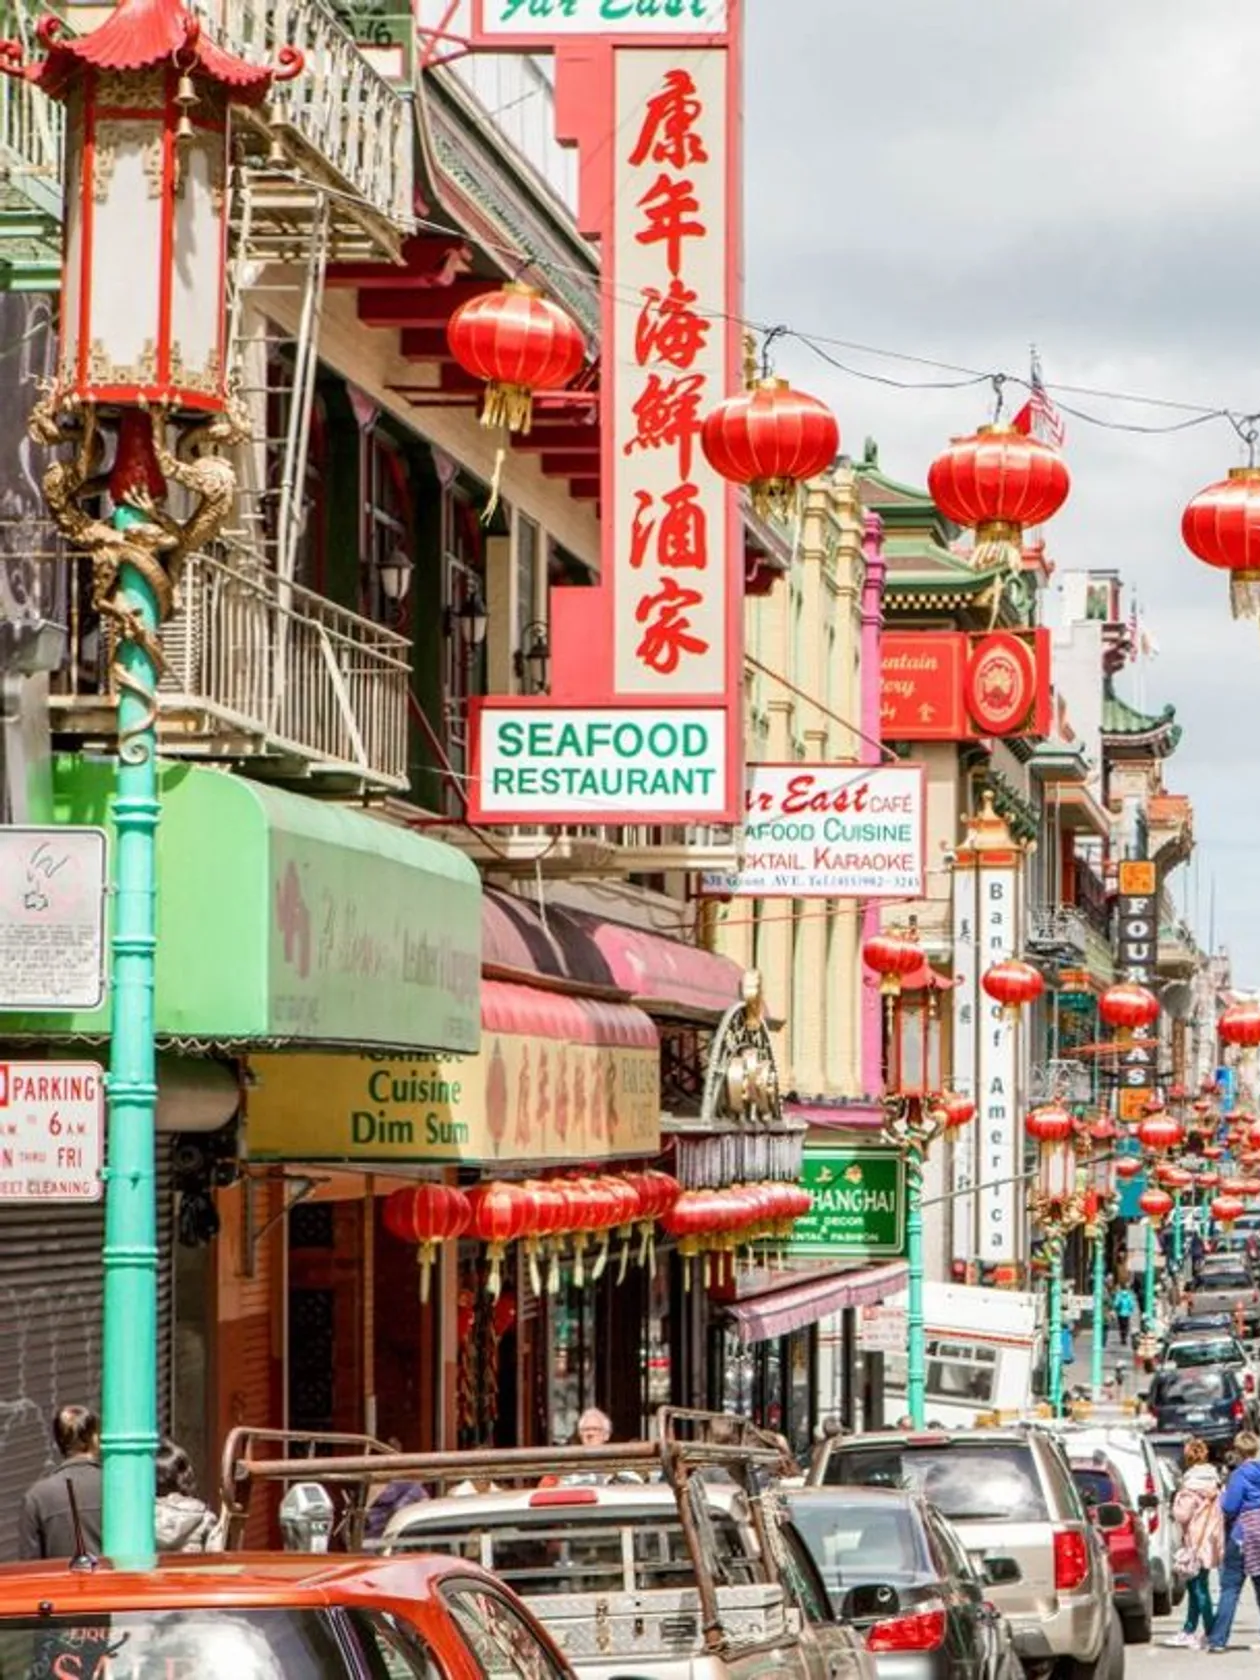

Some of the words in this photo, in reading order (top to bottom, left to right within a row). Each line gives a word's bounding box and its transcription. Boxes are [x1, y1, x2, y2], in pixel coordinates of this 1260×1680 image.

[623, 69, 709, 674] 康年海鮮酒家
[497, 722, 708, 758] SEAFOOD
[493, 768, 716, 796] RESTAURANT
[781, 775, 868, 814] East
[745, 823, 814, 842] AFOOD
[746, 853, 805, 871] CKTAIL
[989, 883, 1004, 974] Ban
[13, 1076, 95, 1101] PARKING
[368, 1069, 462, 1104] Cuisine
[49, 1111, 62, 1136] 6
[352, 1112, 413, 1144] Dim
[426, 1112, 469, 1145] Sum
[57, 1147, 82, 1168] FRI
[988, 1077, 1006, 1247] America
[27, 1181, 90, 1195] CLEANING
[811, 1188, 896, 1213] HANGHAI
